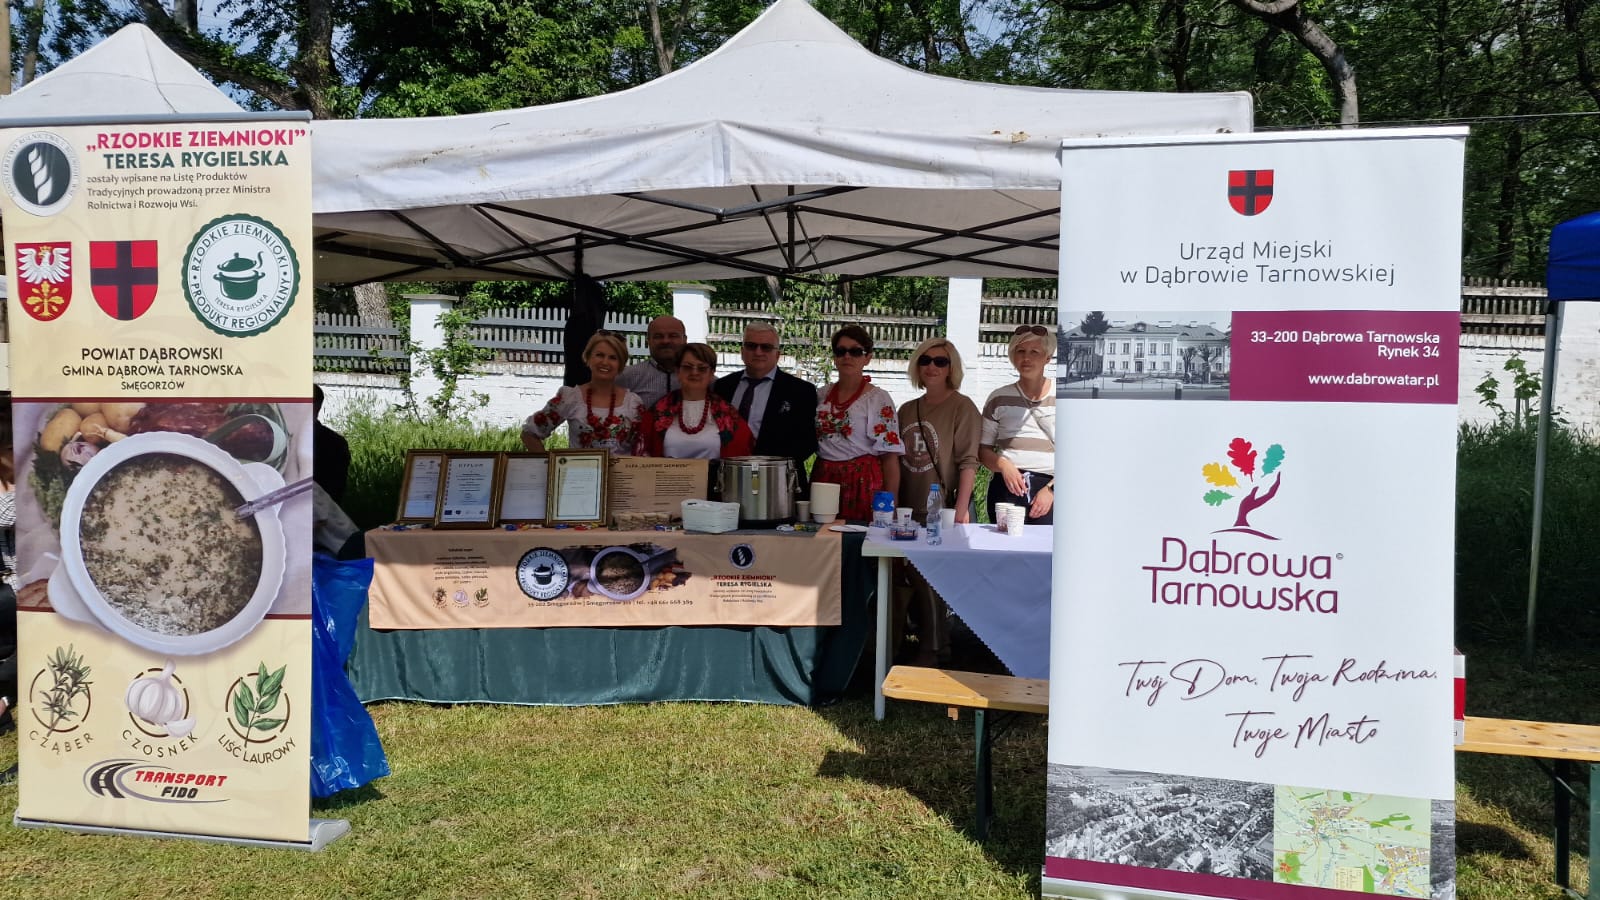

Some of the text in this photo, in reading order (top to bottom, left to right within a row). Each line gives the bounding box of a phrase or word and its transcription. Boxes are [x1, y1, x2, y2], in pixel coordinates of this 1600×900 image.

[86, 129, 306, 152] „RZODKIE ZIEMNIOKI”
[103, 150, 289, 169] TERESA RYGIELSKA
[86, 173, 119, 184] zostały
[121, 173, 158, 183] wpisane
[173, 173, 194, 183] Listę
[196, 172, 248, 182] Produktów
[87, 185, 271, 197] Tradycyjnych prowadzoną przez Ministra
[87, 201, 132, 210] Rolnictwa
[138, 200, 178, 210] Rozwoju
[179, 199, 198, 208] Wsi.
[191, 224, 289, 271] RZODKIE ZIEMNIOKI
[1180, 239, 1333, 263] Urząd Miejski
[1120, 263, 1396, 288] w Dąbrowie Tarnowskiej
[191, 278, 291, 328] PRODUKT REGIONALNY
[214, 296, 235, 312] TERESA
[1250, 330, 1440, 346] 33-200 Dąbrowa Tarnowska
[81, 347, 223, 364] POWIAT DĄBROWSKI
[1378, 345, 1440, 359] Rynek 34
[62, 364, 244, 379] GMINA DĄBROWA TARNOWSKA
[1308, 372, 1440, 387] www.dabrowatar.pl
[121, 380, 185, 393] SMĘGORZÓW
[1161, 536, 1332, 580] Dąbrowa
[1142, 565, 1339, 614] Tarnowska
[1118, 660, 1168, 707] Twój
[1262, 653, 1328, 703] Twoja
[1332, 657, 1438, 687] Rodzina.
[1225, 710, 1381, 758] Twoje Miasto
[29, 729, 297, 765] CZĄBER CZOSNEK LIŚĆ LAUROWY
[135, 769, 229, 788] TRANSPORT
[160, 786, 199, 799] FIDO
